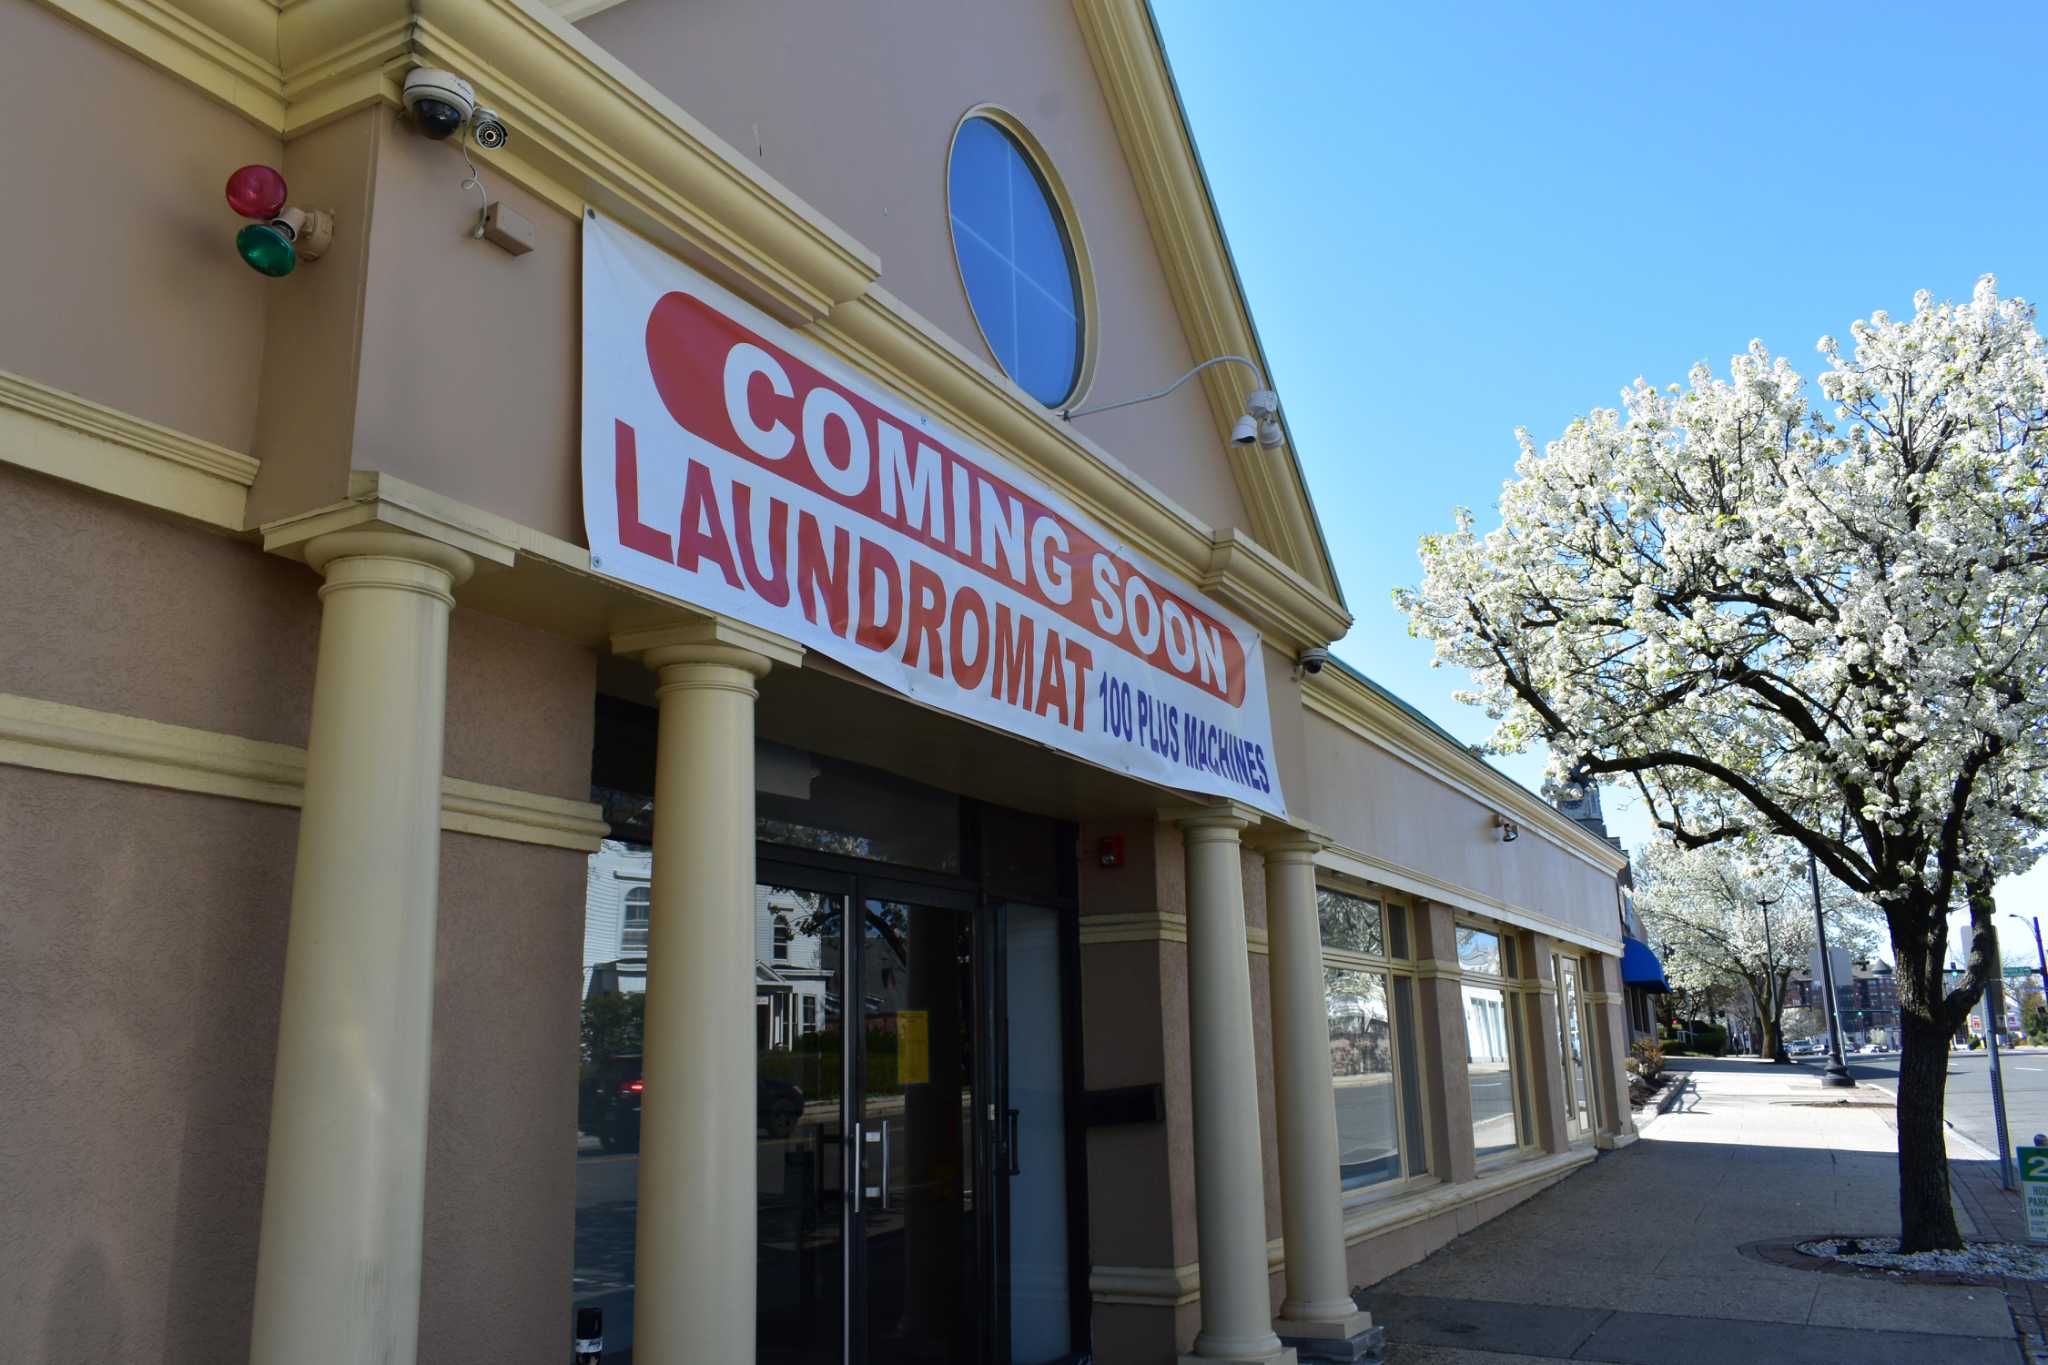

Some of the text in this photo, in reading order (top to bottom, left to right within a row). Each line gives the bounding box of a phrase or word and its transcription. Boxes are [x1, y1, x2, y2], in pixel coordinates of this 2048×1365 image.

[614, 417, 1094, 733] LAUNDROMAT
[723, 342, 1228, 695] COMING SOON
[1099, 671, 1271, 794] 100 PLUS MACHINES
[2027, 1156, 2048, 1177] 2
